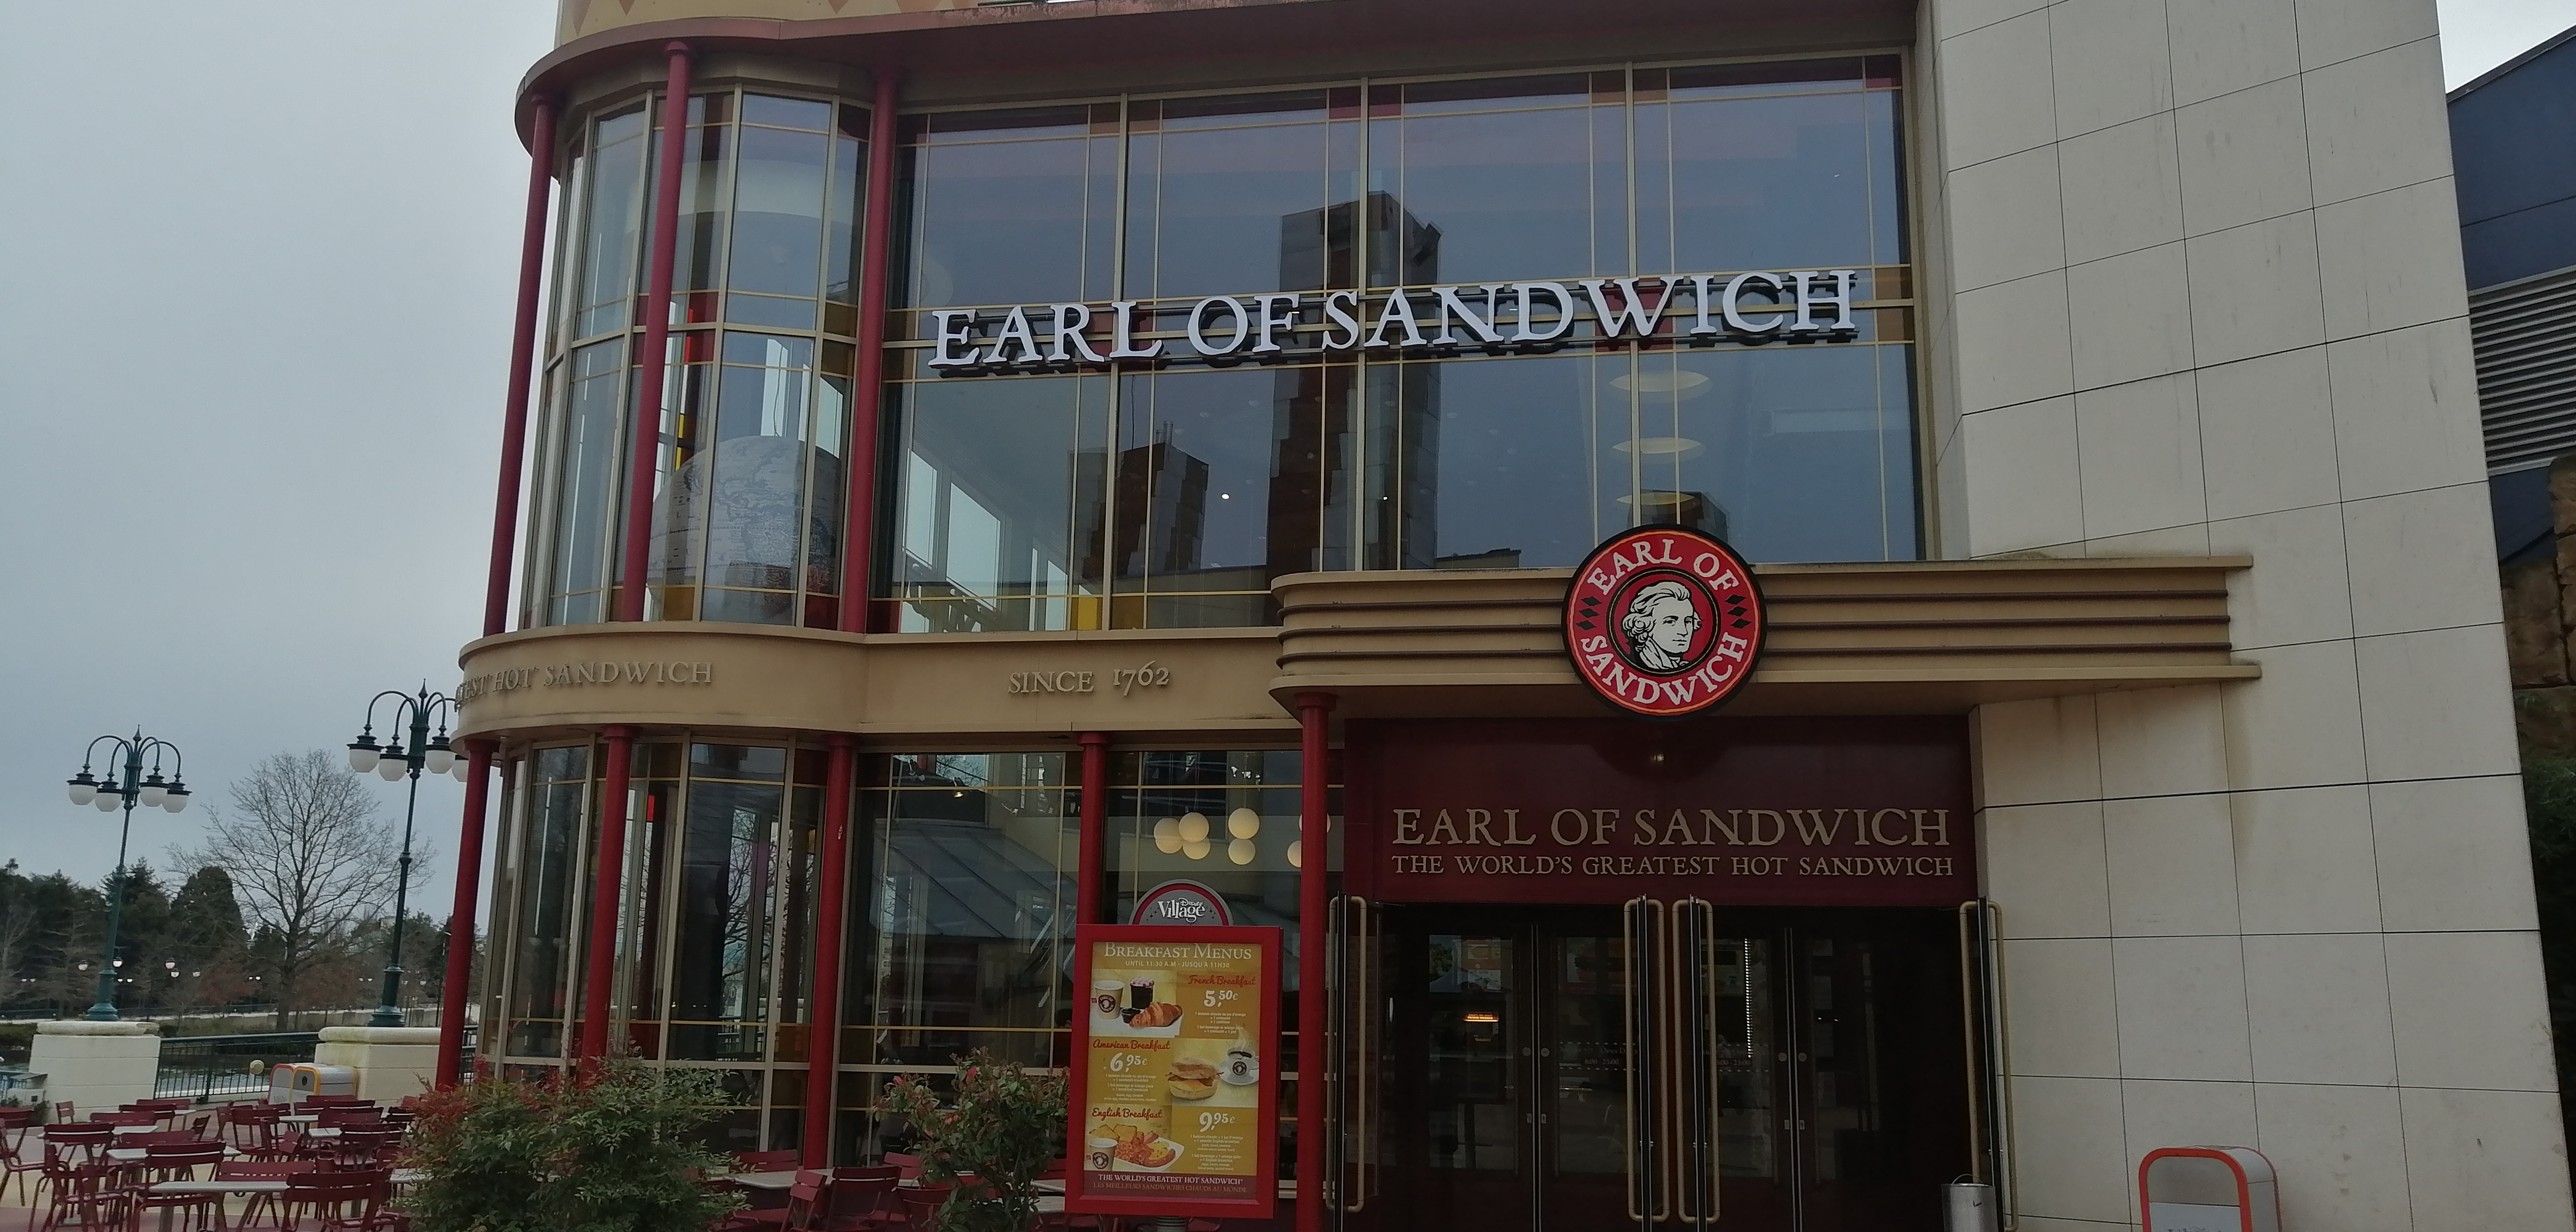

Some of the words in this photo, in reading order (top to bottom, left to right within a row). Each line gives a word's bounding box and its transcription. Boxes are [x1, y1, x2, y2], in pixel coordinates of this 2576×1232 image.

[927, 300, 1163, 366] EARL
[1187, 293, 1300, 356] OF
[1321, 269, 1857, 350] SANDWICH
[1587, 538, 1682, 595] EARL
[1694, 553, 1739, 591] OF
[493, 667, 539, 692] HOT
[543, 661, 713, 685] SANDWICH
[1008, 671, 1094, 693] SINCE
[1113, 660, 1169, 696] 1762
[1581, 632, 1748, 705] SANDWICH
[1392, 808, 1537, 846] EARL
[1550, 808, 1621, 846] OF
[1633, 808, 1950, 846] SANDWICH
[1392, 855, 1444, 875] THE
[1454, 856, 1572, 875] WORLD'S
[1582, 856, 1721, 876] GREATEST
[1731, 857, 1789, 876] HOT
[1799, 857, 1954, 877] SANDWICH
[1158, 900, 1205, 923] Village
[1188, 974, 1215, 985] French
[1215, 975, 1256, 988] Breakfast
[1093, 1039, 1130, 1048] American
[1130, 1040, 1171, 1052] Breakfast
[1092, 1107, 1121, 1121] English
[1122, 1108, 1163, 1121] Breakfast
